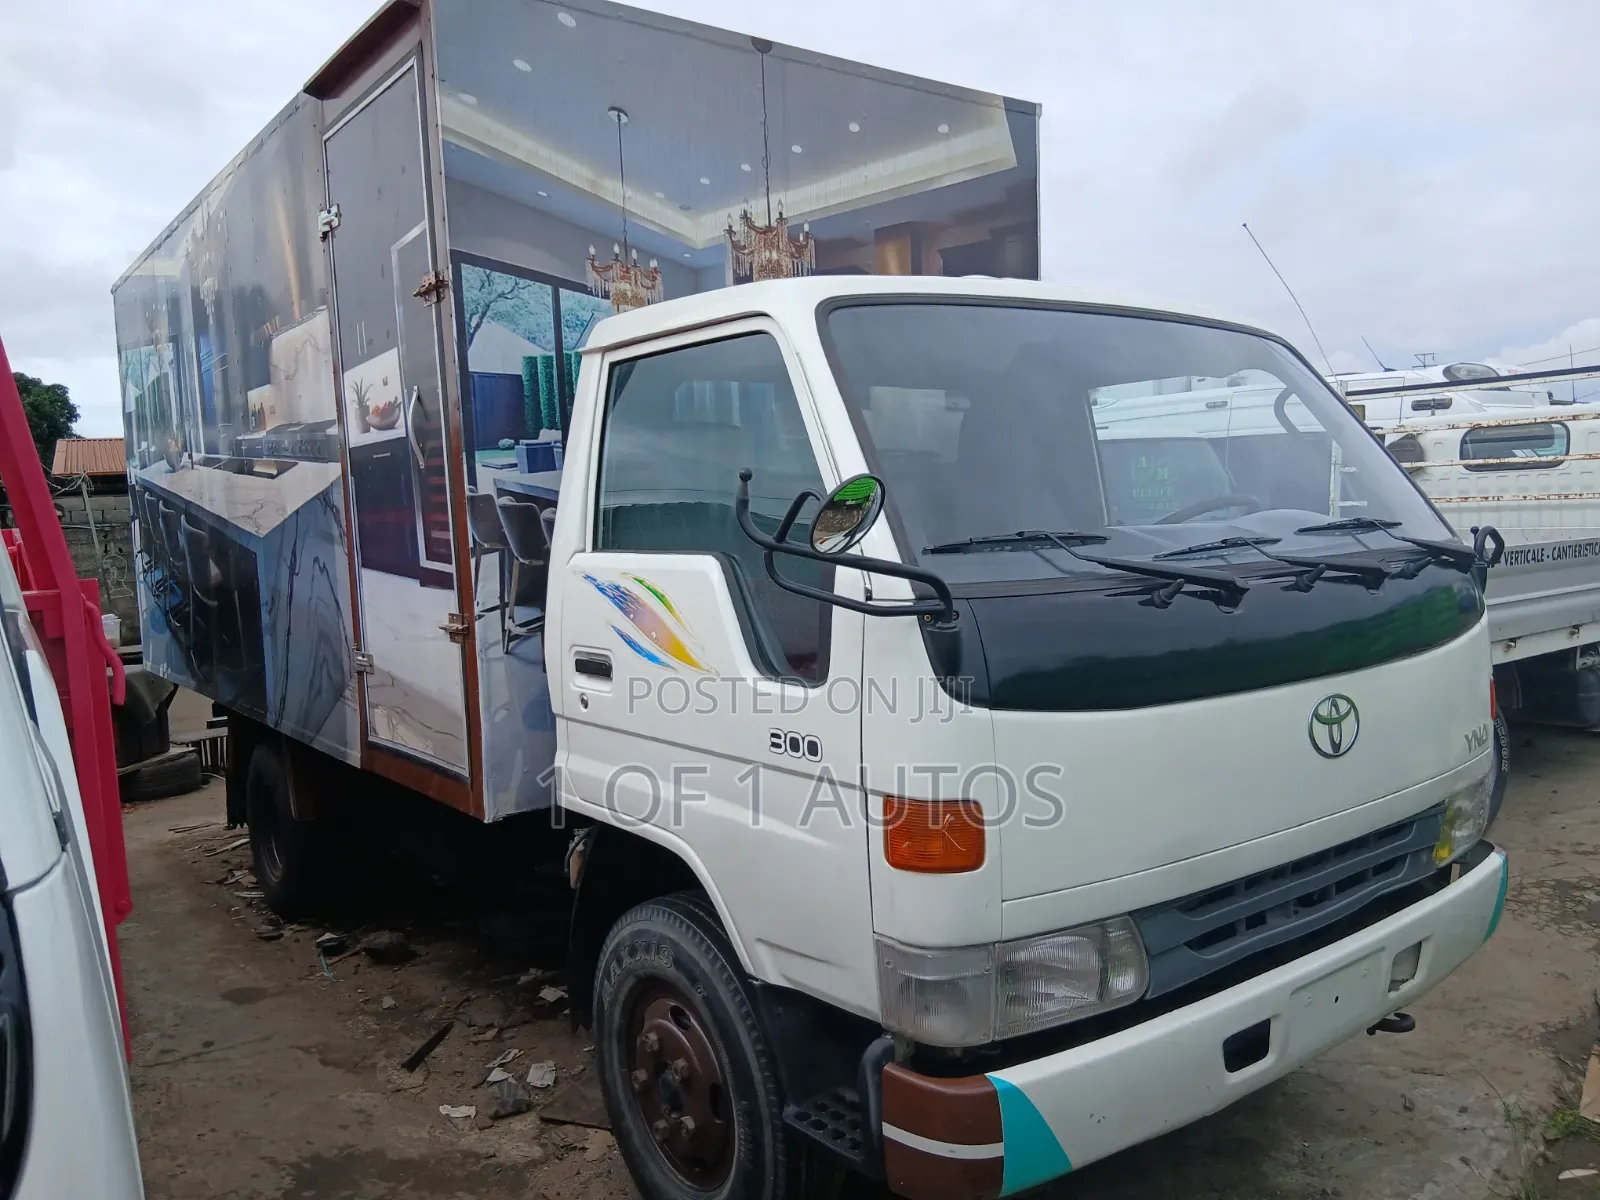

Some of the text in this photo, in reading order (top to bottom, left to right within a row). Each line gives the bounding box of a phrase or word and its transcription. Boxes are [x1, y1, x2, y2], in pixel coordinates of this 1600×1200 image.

[1504, 548, 1545, 566] VERTICALE
[768, 727, 823, 762] 300
[603, 940, 675, 1011] MAXXIS
